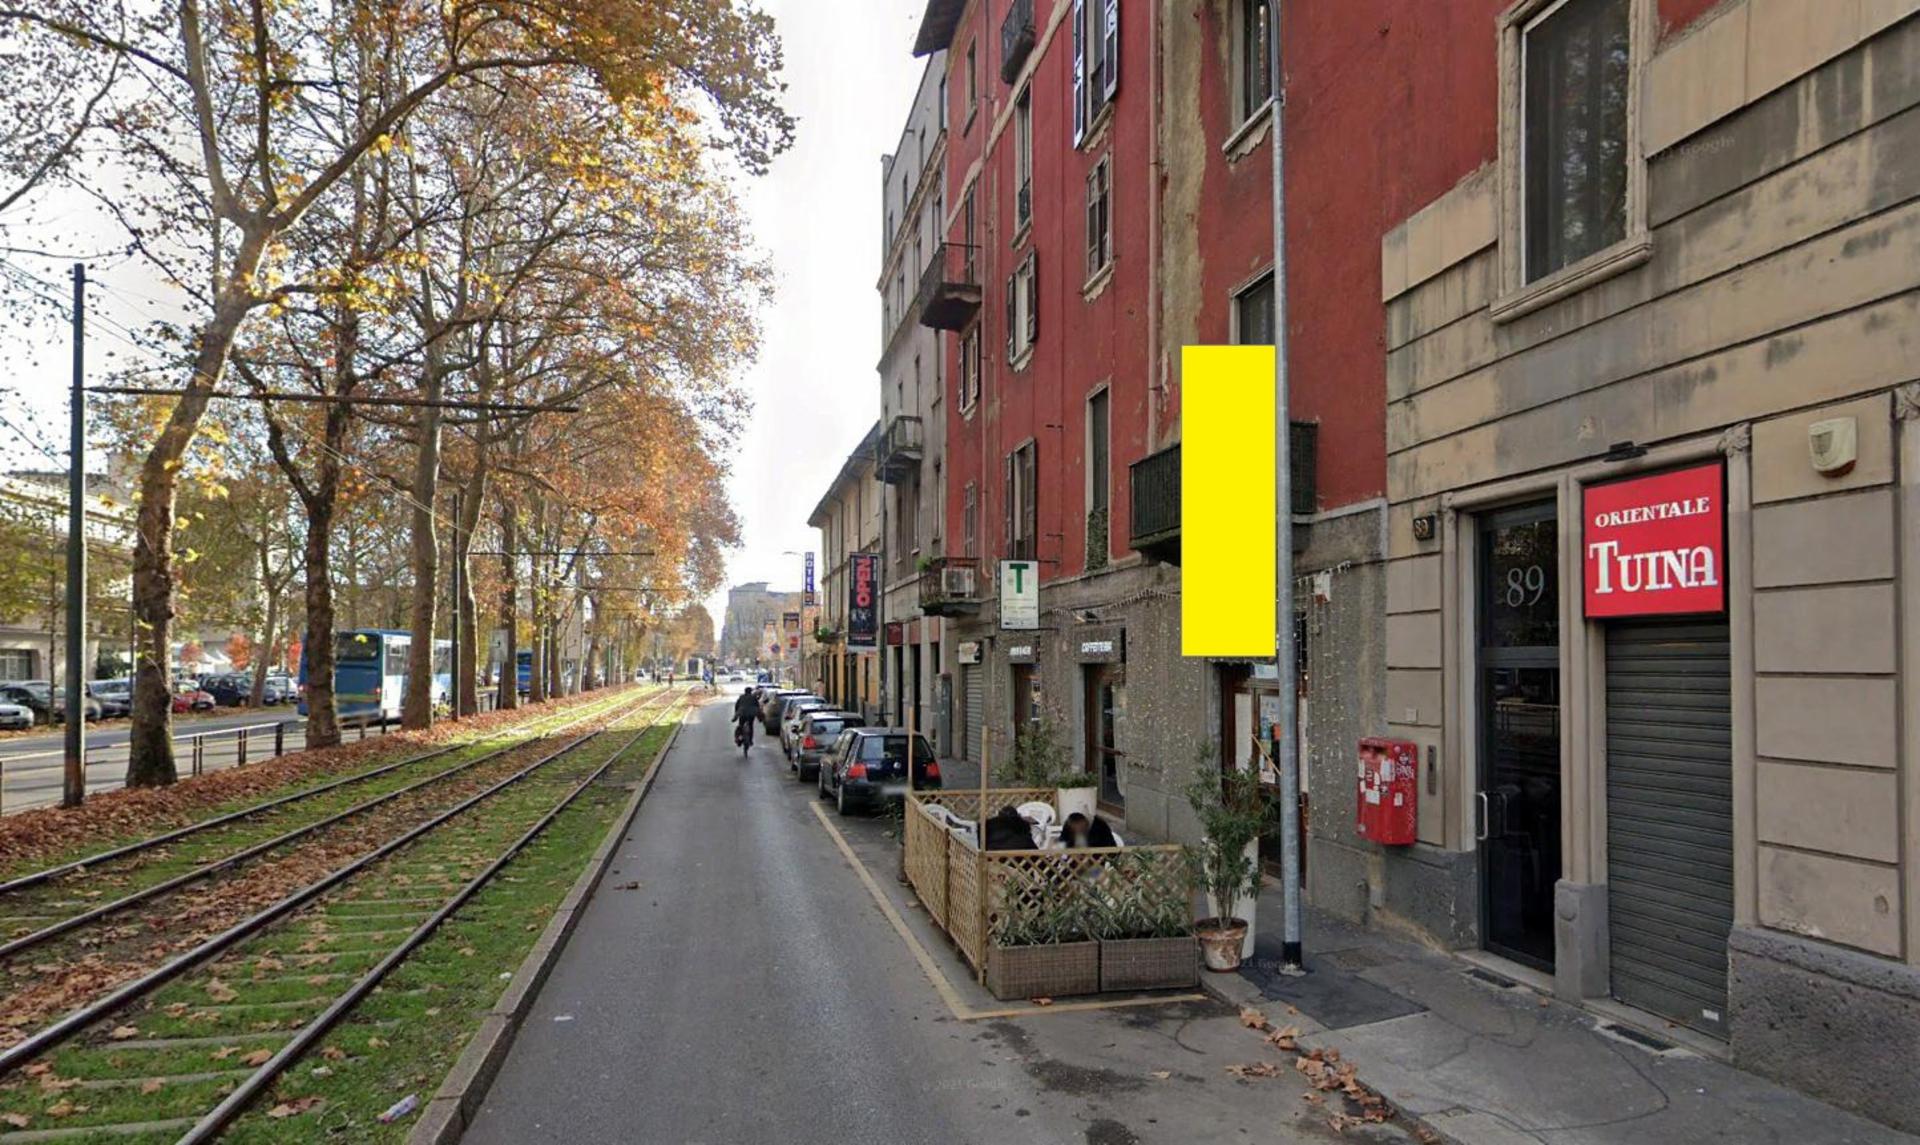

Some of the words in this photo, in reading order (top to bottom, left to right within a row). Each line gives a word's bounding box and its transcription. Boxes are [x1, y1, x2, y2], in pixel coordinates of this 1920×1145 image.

[1415, 519, 1429, 538] 89
[1595, 497, 1710, 528] ORIENTALE
[806, 553, 814, 592] HOTEL
[856, 558, 871, 608] OPEN
[1009, 563, 1029, 594] T
[1507, 565, 1544, 607] 89
[1589, 540, 1718, 594] TUINA
